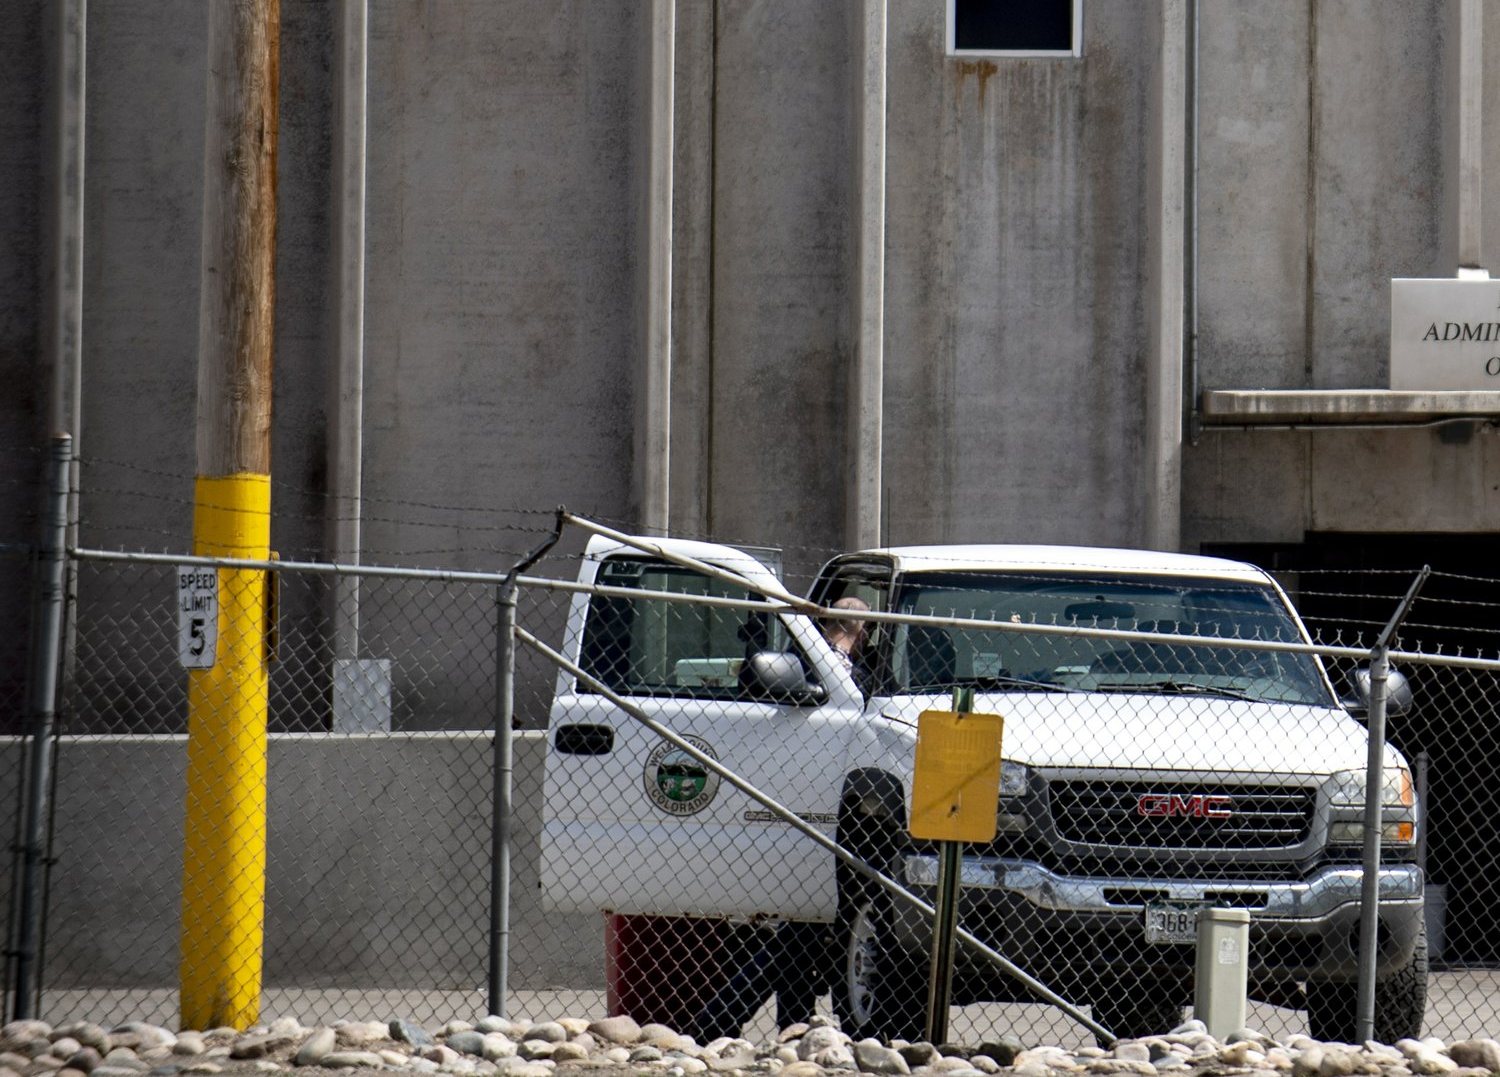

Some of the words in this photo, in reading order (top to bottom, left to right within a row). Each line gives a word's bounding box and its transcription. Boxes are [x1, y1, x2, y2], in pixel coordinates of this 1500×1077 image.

[180, 573, 216, 590] SPEED
[183, 595, 213, 612] LIMIT
[190, 618, 206, 657] 5
[652, 789, 709, 813] COLORADO
[1138, 794, 1232, 818] GMC
